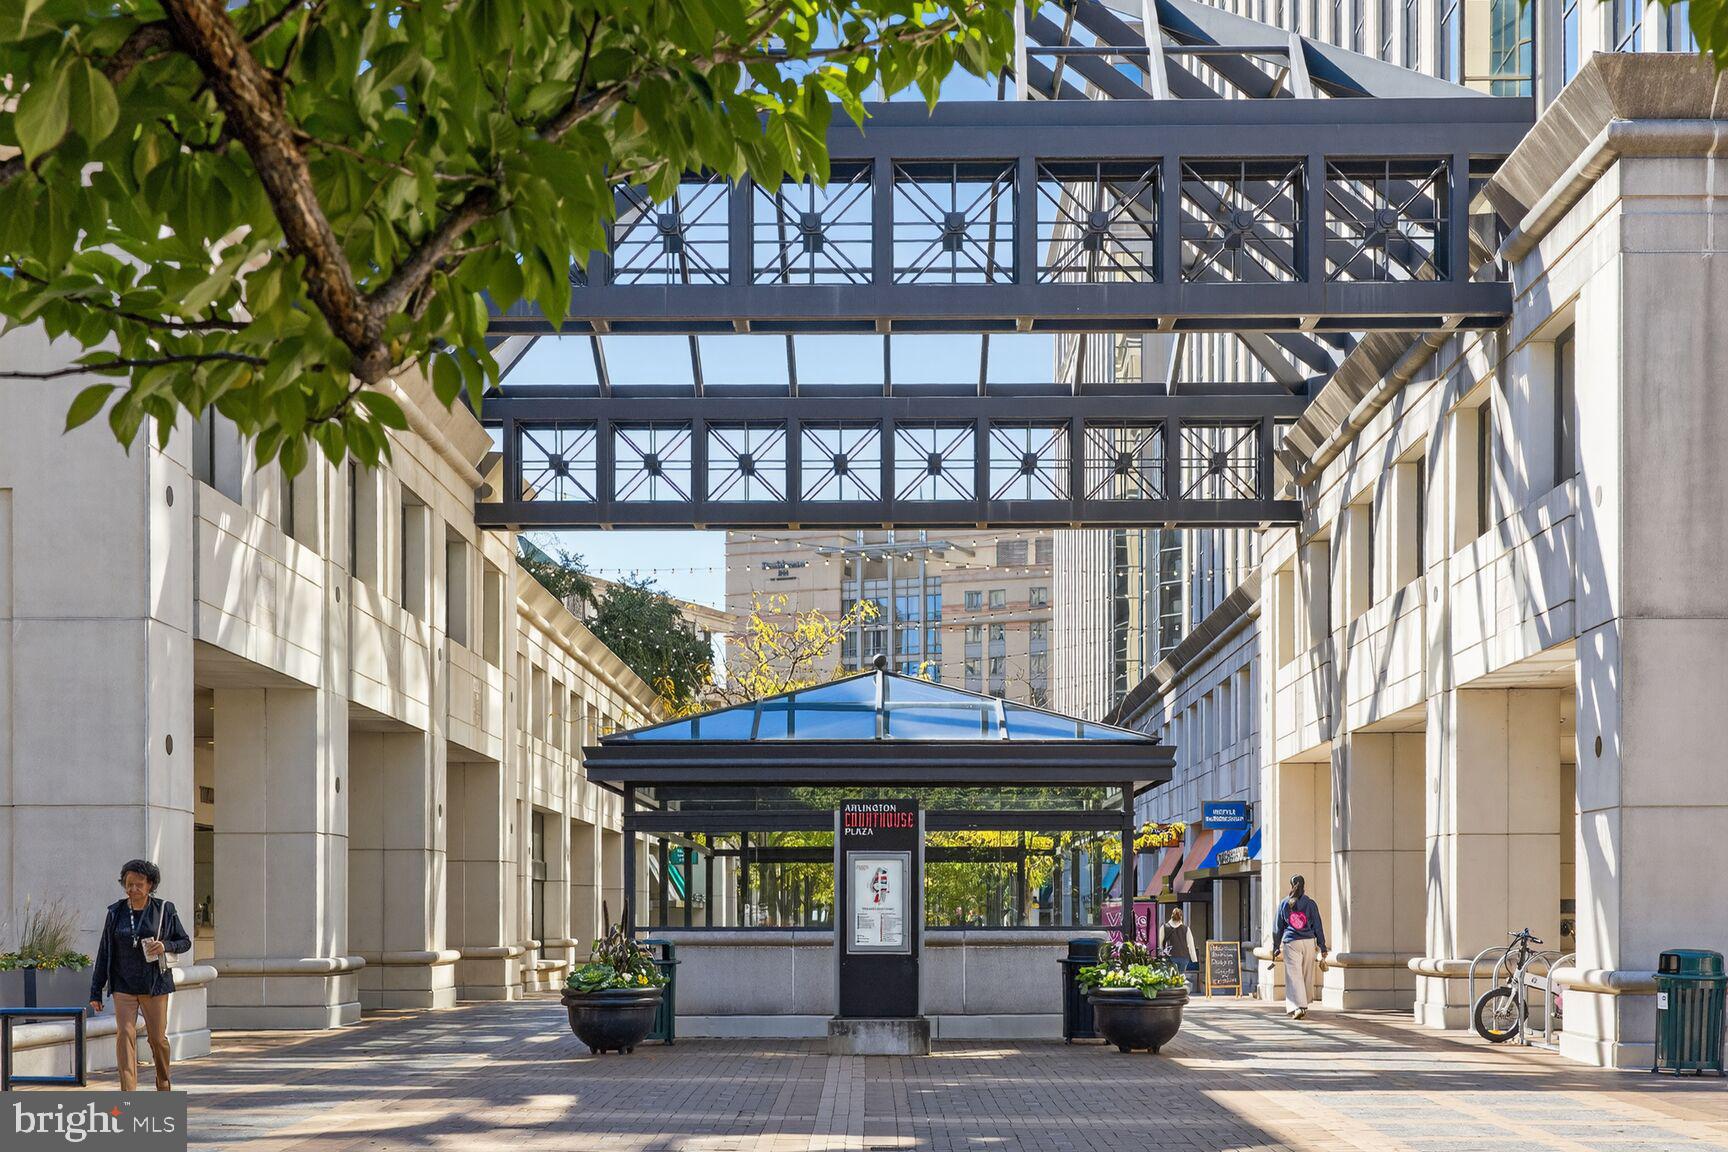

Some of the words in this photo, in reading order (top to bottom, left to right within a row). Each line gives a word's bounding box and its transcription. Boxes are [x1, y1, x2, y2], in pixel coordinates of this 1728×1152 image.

[845, 804, 897, 812] ARLINGTON
[845, 812, 914, 828] COURTHOUSE
[844, 828, 874, 836] PLAZA
